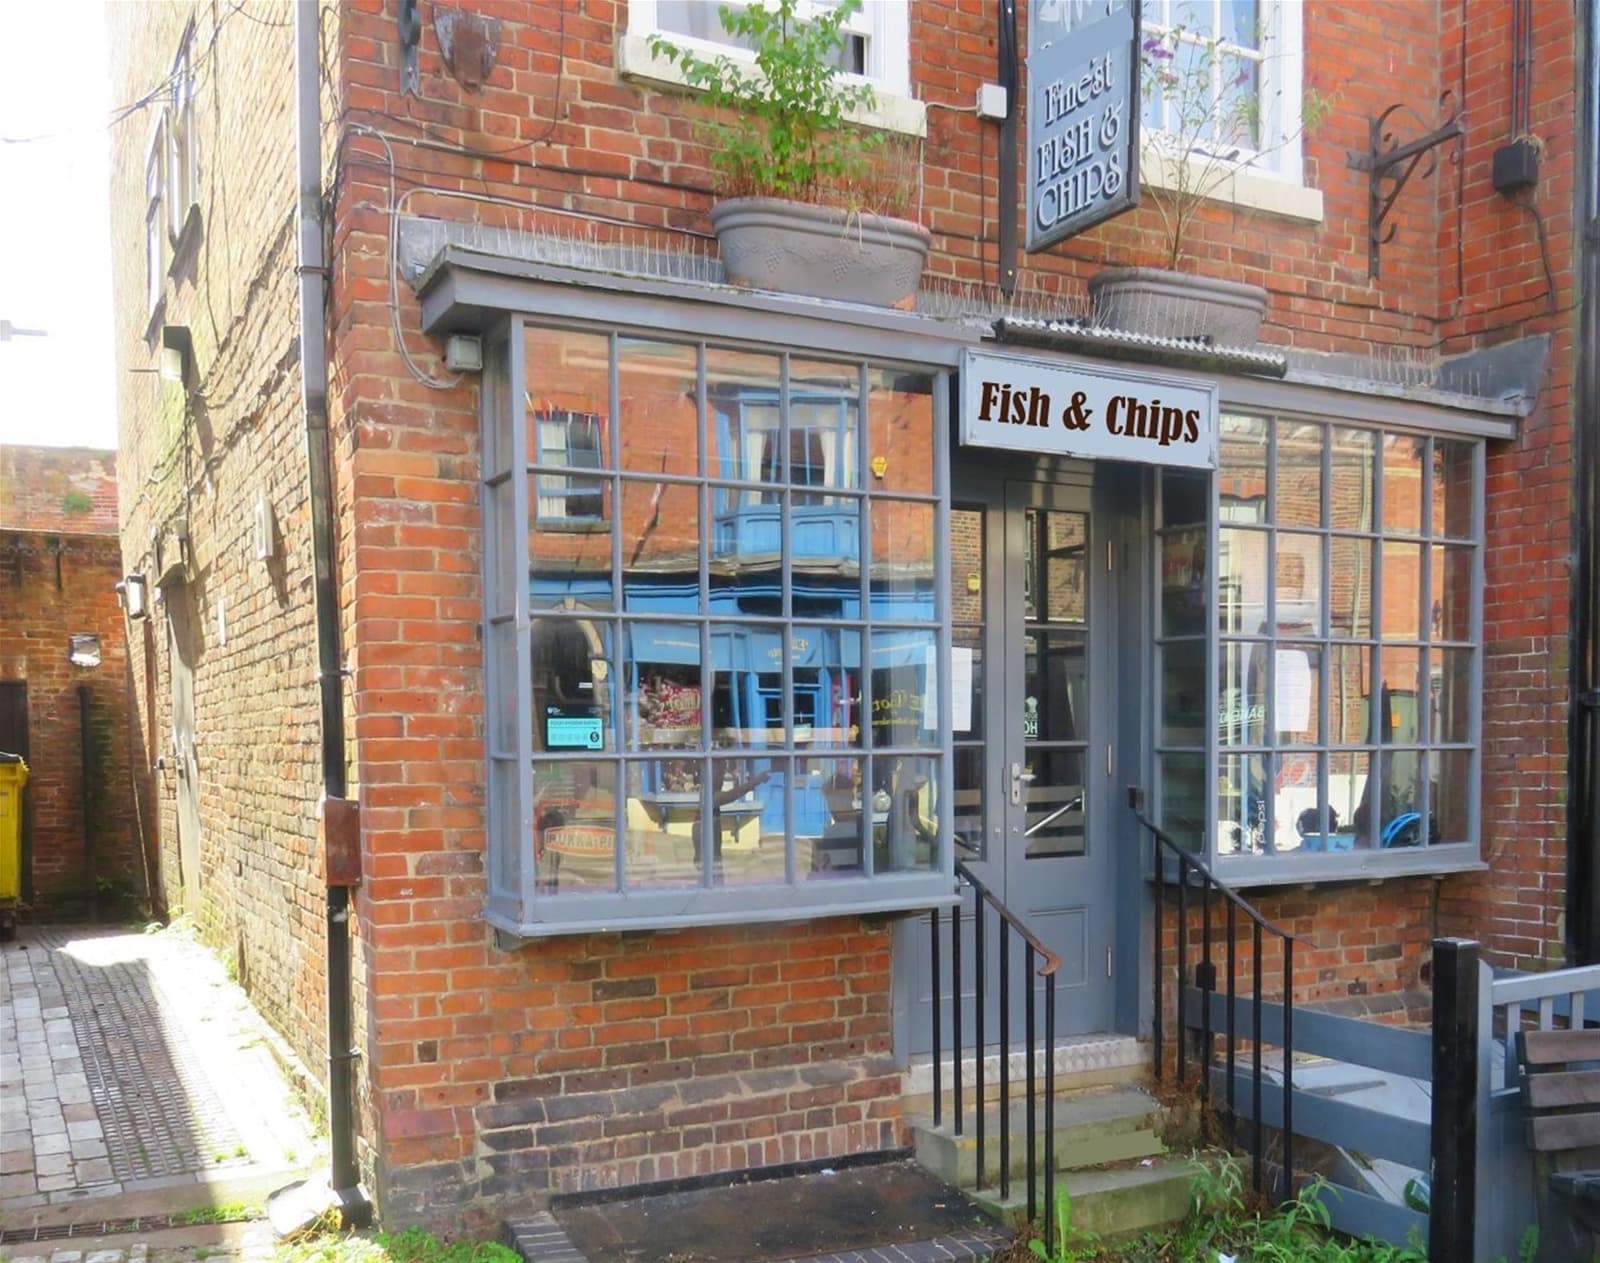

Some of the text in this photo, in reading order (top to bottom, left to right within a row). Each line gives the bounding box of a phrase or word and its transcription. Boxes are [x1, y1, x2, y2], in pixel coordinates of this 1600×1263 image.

[1044, 52, 1114, 128] Finest
[1099, 99, 1123, 150] &
[978, 381, 1200, 446] Fish & Chips
[1256, 800, 1267, 844] pepsi
